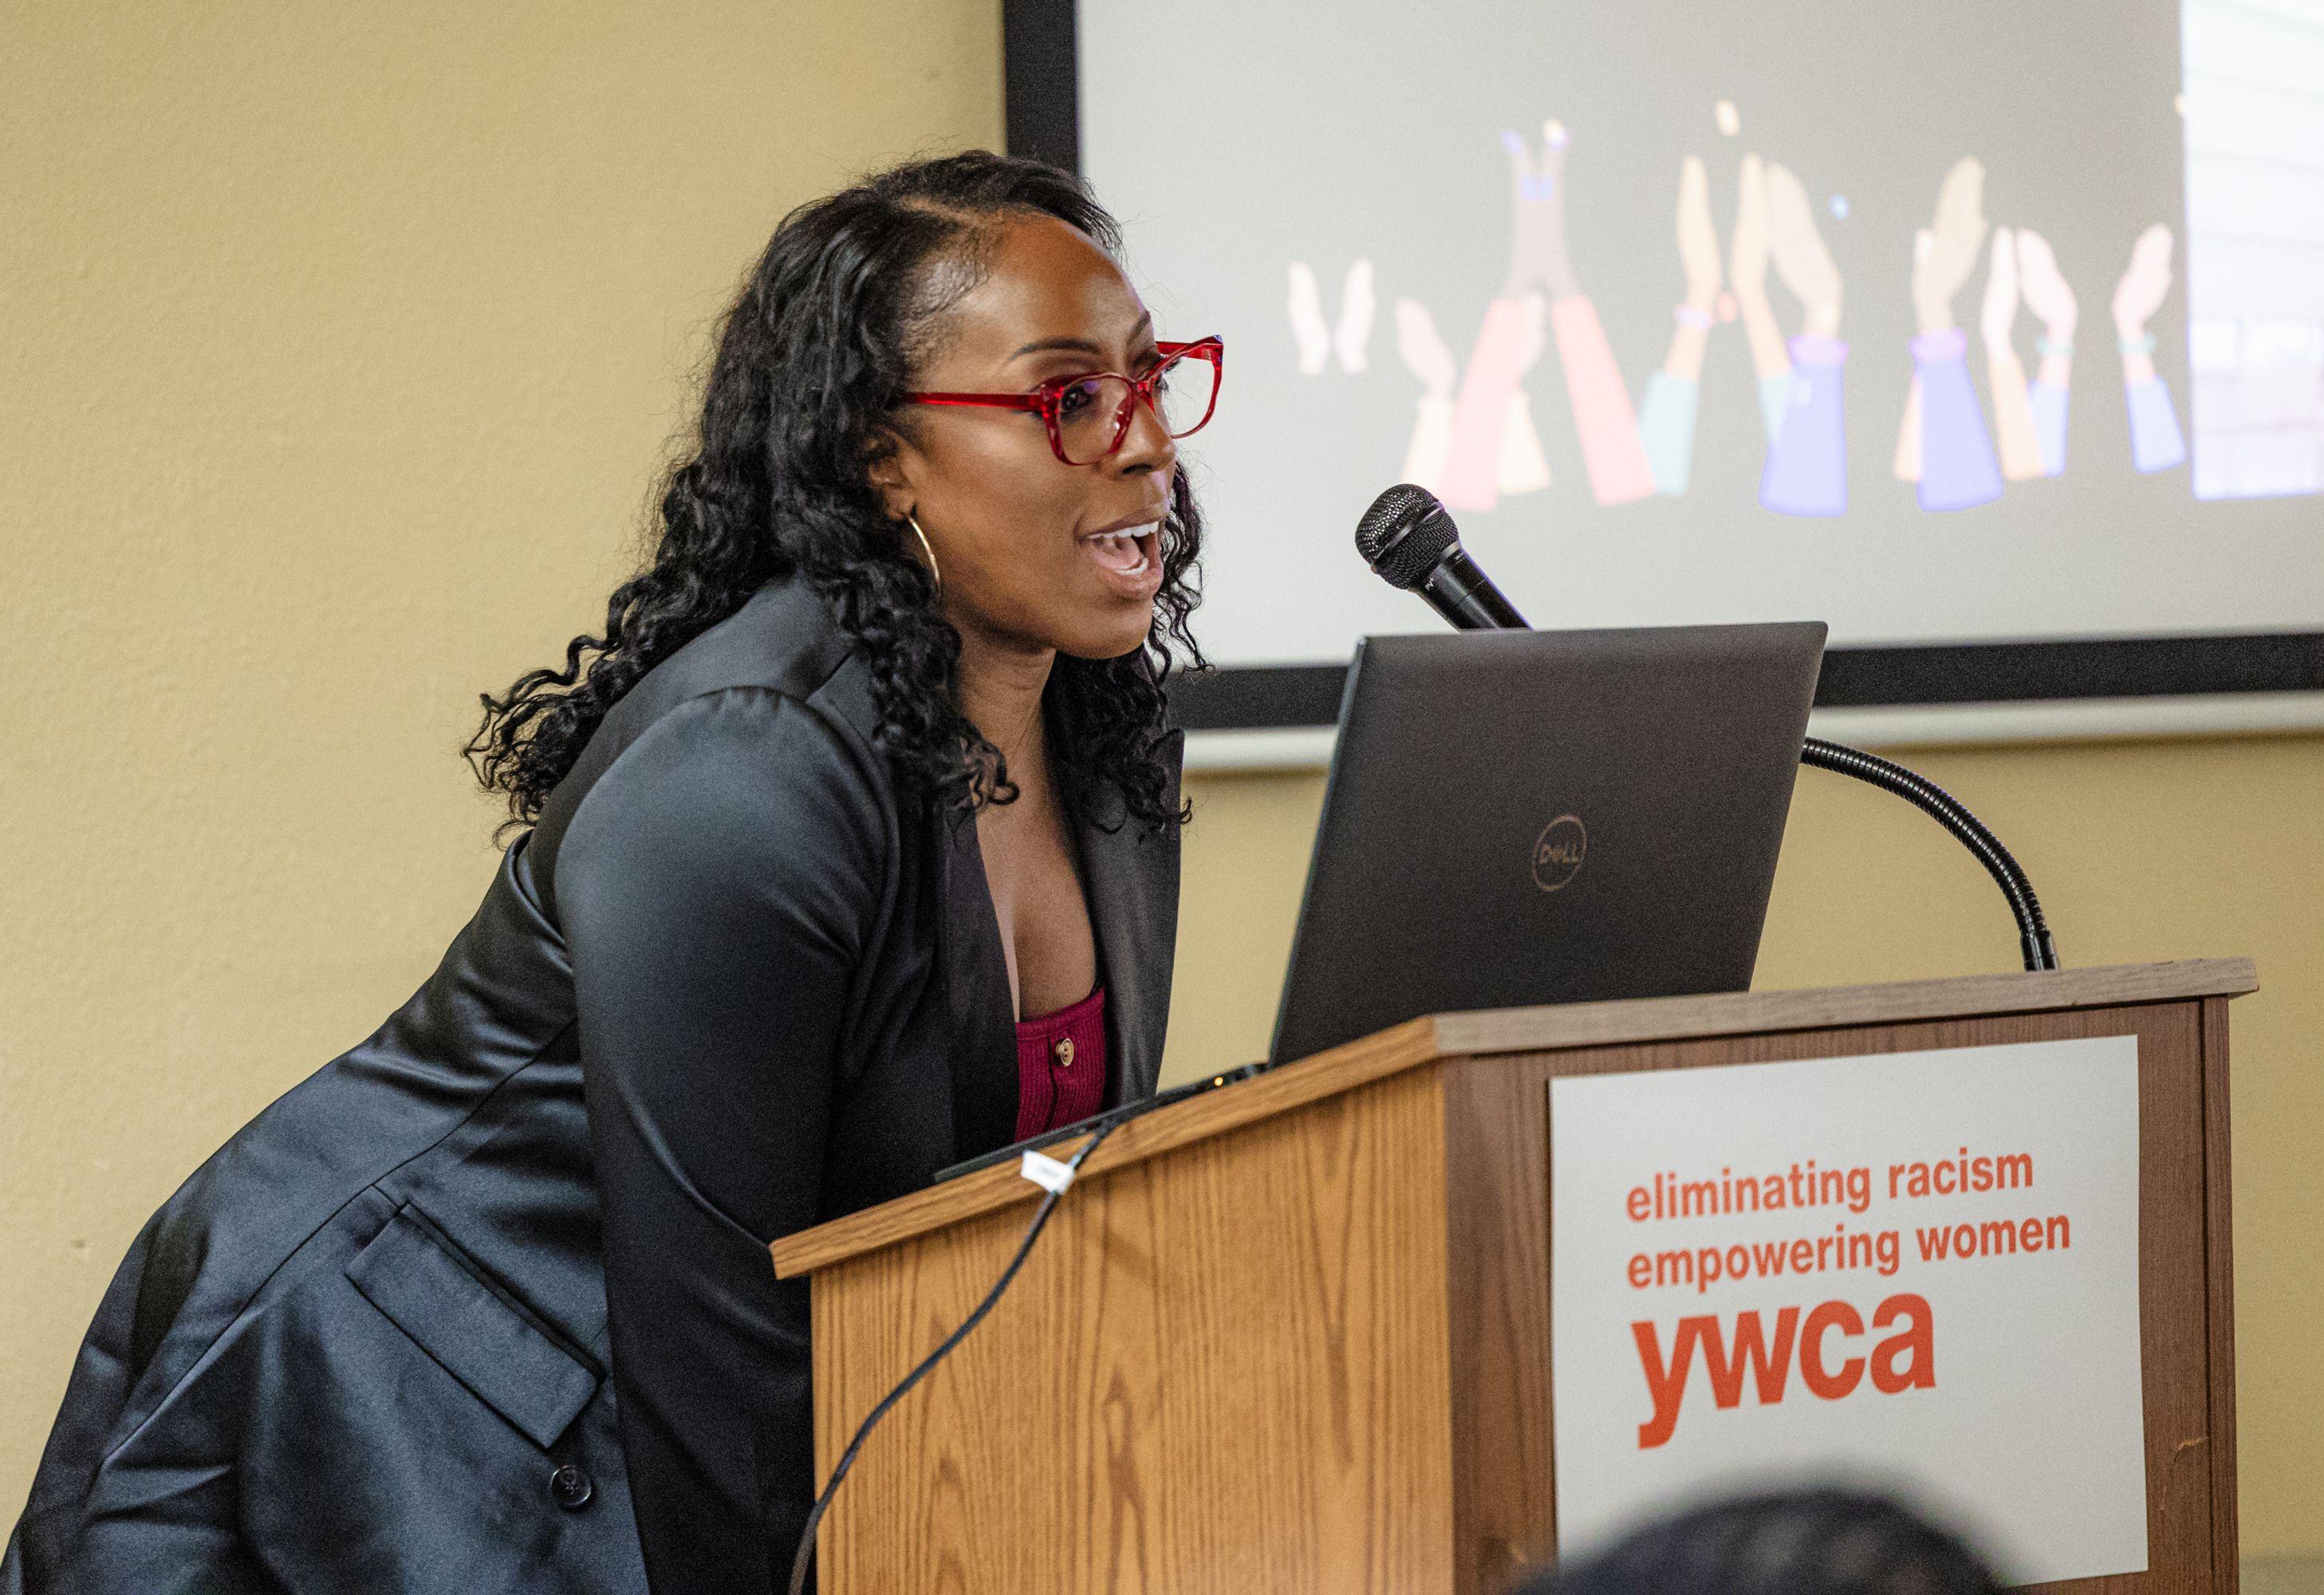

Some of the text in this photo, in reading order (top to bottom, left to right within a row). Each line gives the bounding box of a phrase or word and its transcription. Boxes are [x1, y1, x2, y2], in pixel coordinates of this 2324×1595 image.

[1626, 1147, 2034, 1223] eliminating racism
[1627, 1215, 2071, 1294] empowering women
[1631, 1293, 1936, 1450] ywca
